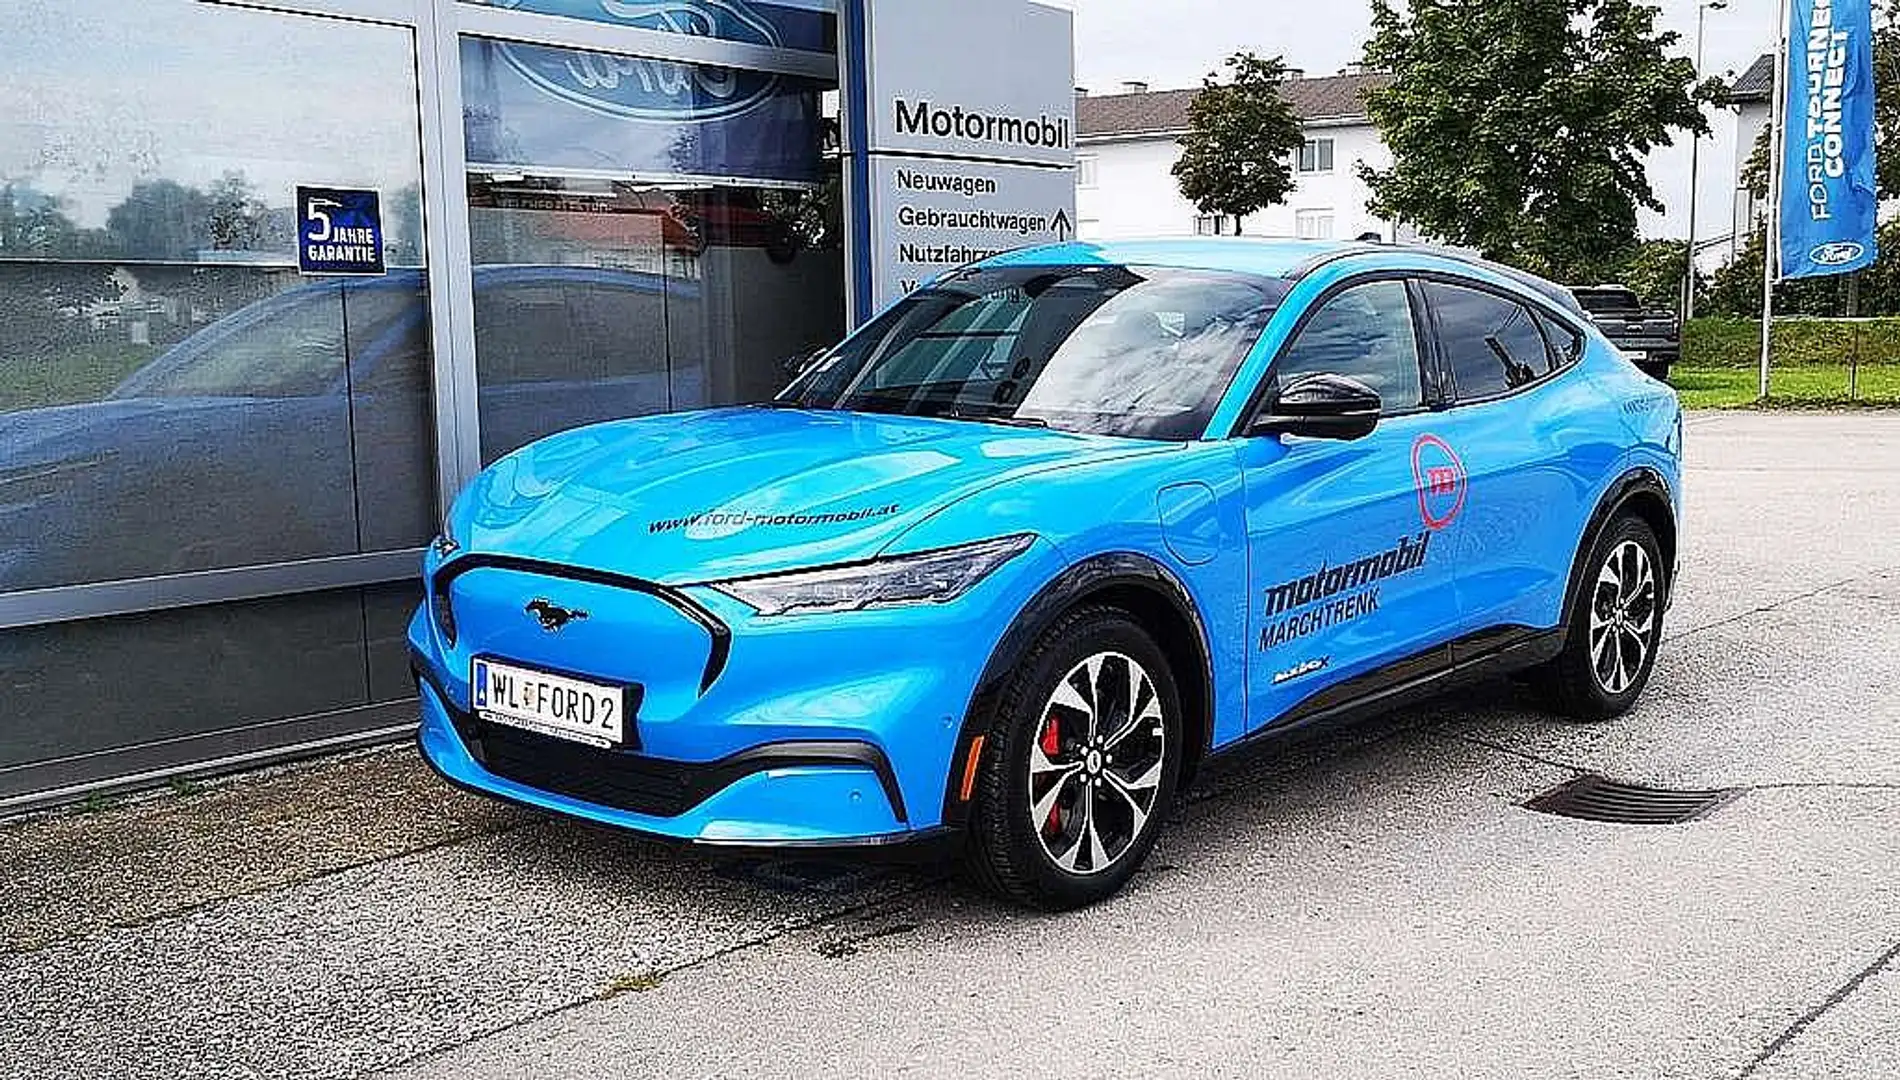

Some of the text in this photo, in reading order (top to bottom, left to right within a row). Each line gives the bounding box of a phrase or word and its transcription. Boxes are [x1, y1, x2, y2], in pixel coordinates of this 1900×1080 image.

[895, 99, 1069, 149] Motormobil
[1821, 25, 1848, 178] CONNECT
[897, 169, 996, 196] Neuwagen
[1807, 143, 1832, 219] FORD
[308, 197, 375, 244] 5 JAHRE
[899, 206, 1046, 235] Gebrauchtwagen
[308, 245, 376, 262] GARANTIE
[649, 503, 899, 533] www.ford-motormobil.at
[1264, 530, 1431, 617] motormobil
[1259, 586, 1380, 651] MARCHTRENK
[492, 672, 614, 729] WL FORD 2
